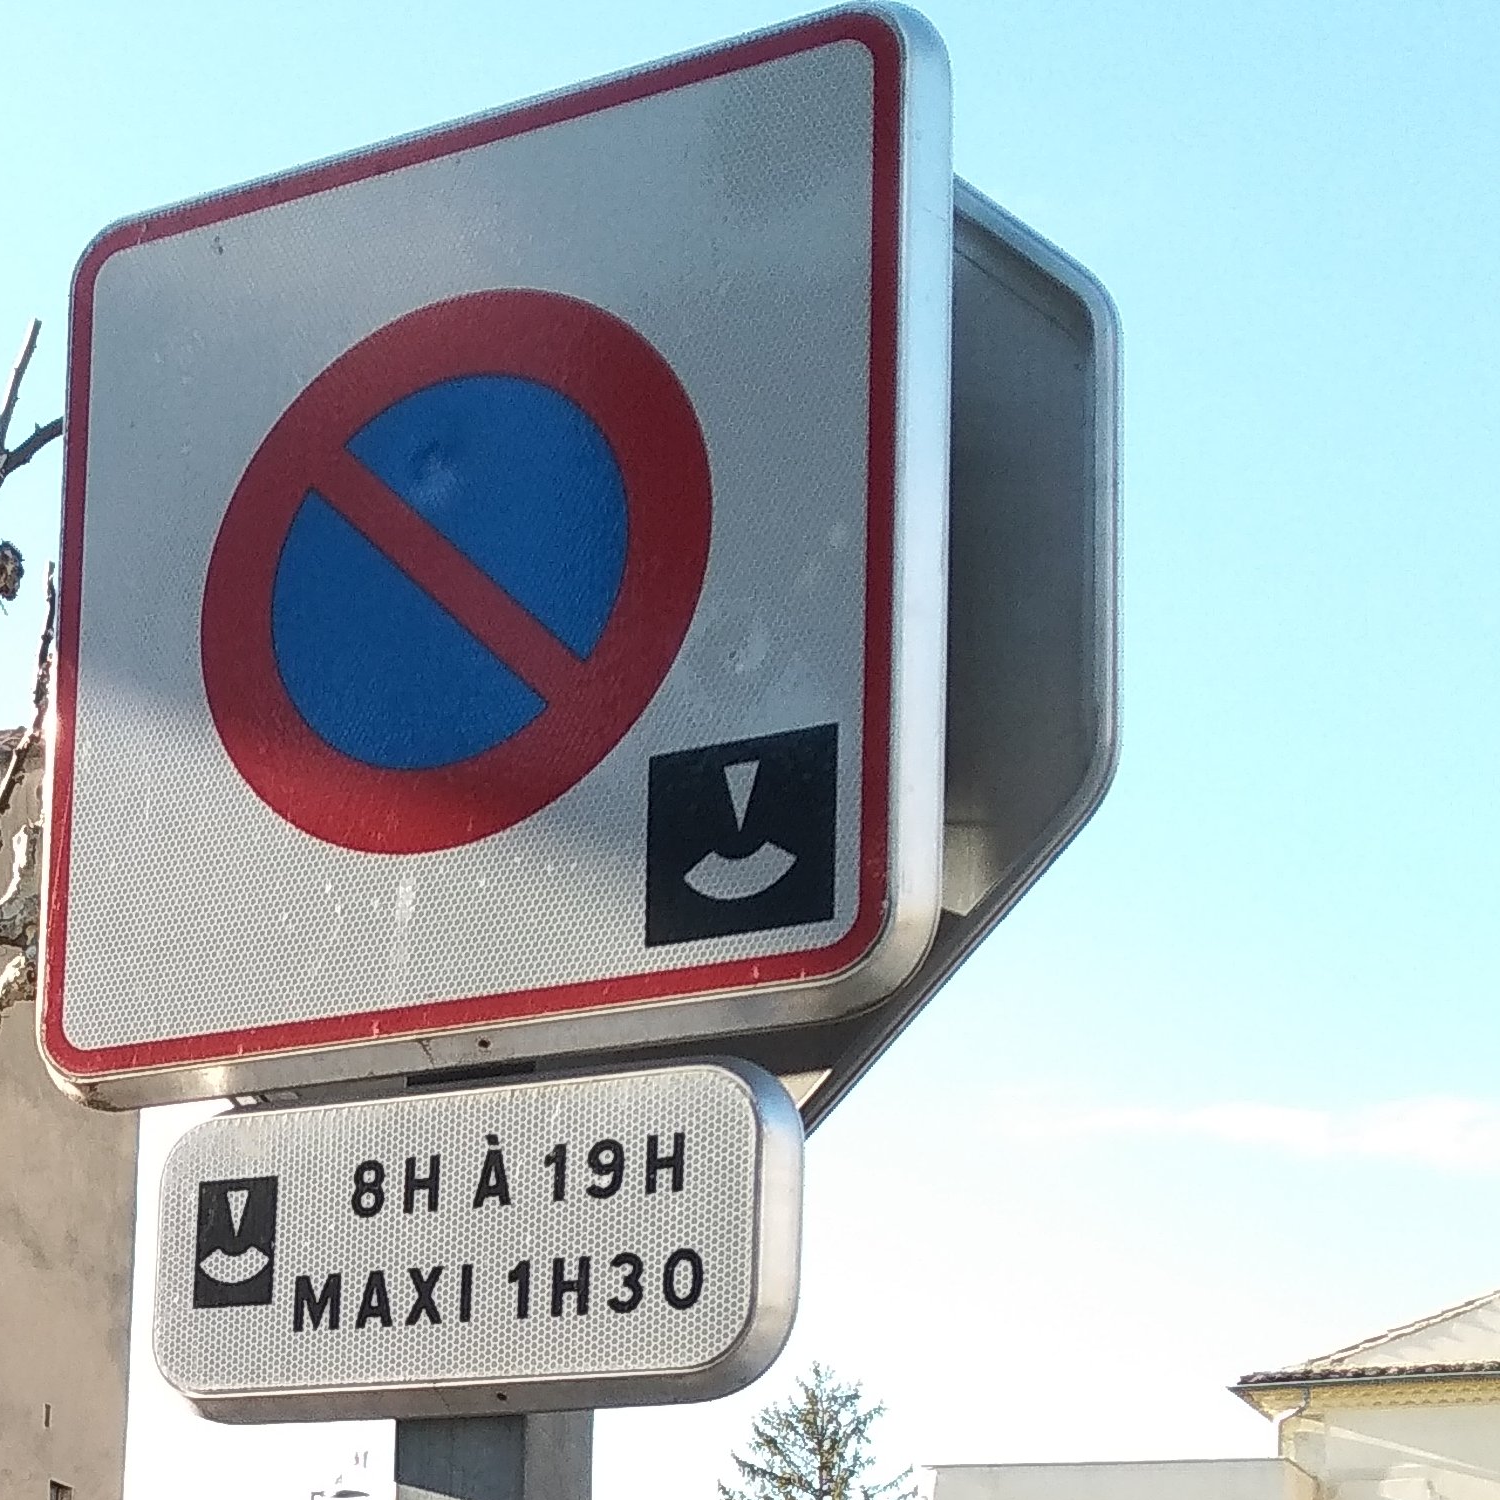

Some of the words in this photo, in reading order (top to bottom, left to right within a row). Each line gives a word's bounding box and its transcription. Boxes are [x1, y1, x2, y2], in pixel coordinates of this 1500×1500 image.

[351, 1154, 441, 1219] 8H
[472, 1133, 511, 1209] À
[543, 1131, 687, 1202] 19H
[292, 1262, 474, 1333] MAXI
[508, 1247, 702, 1320] 1H30
